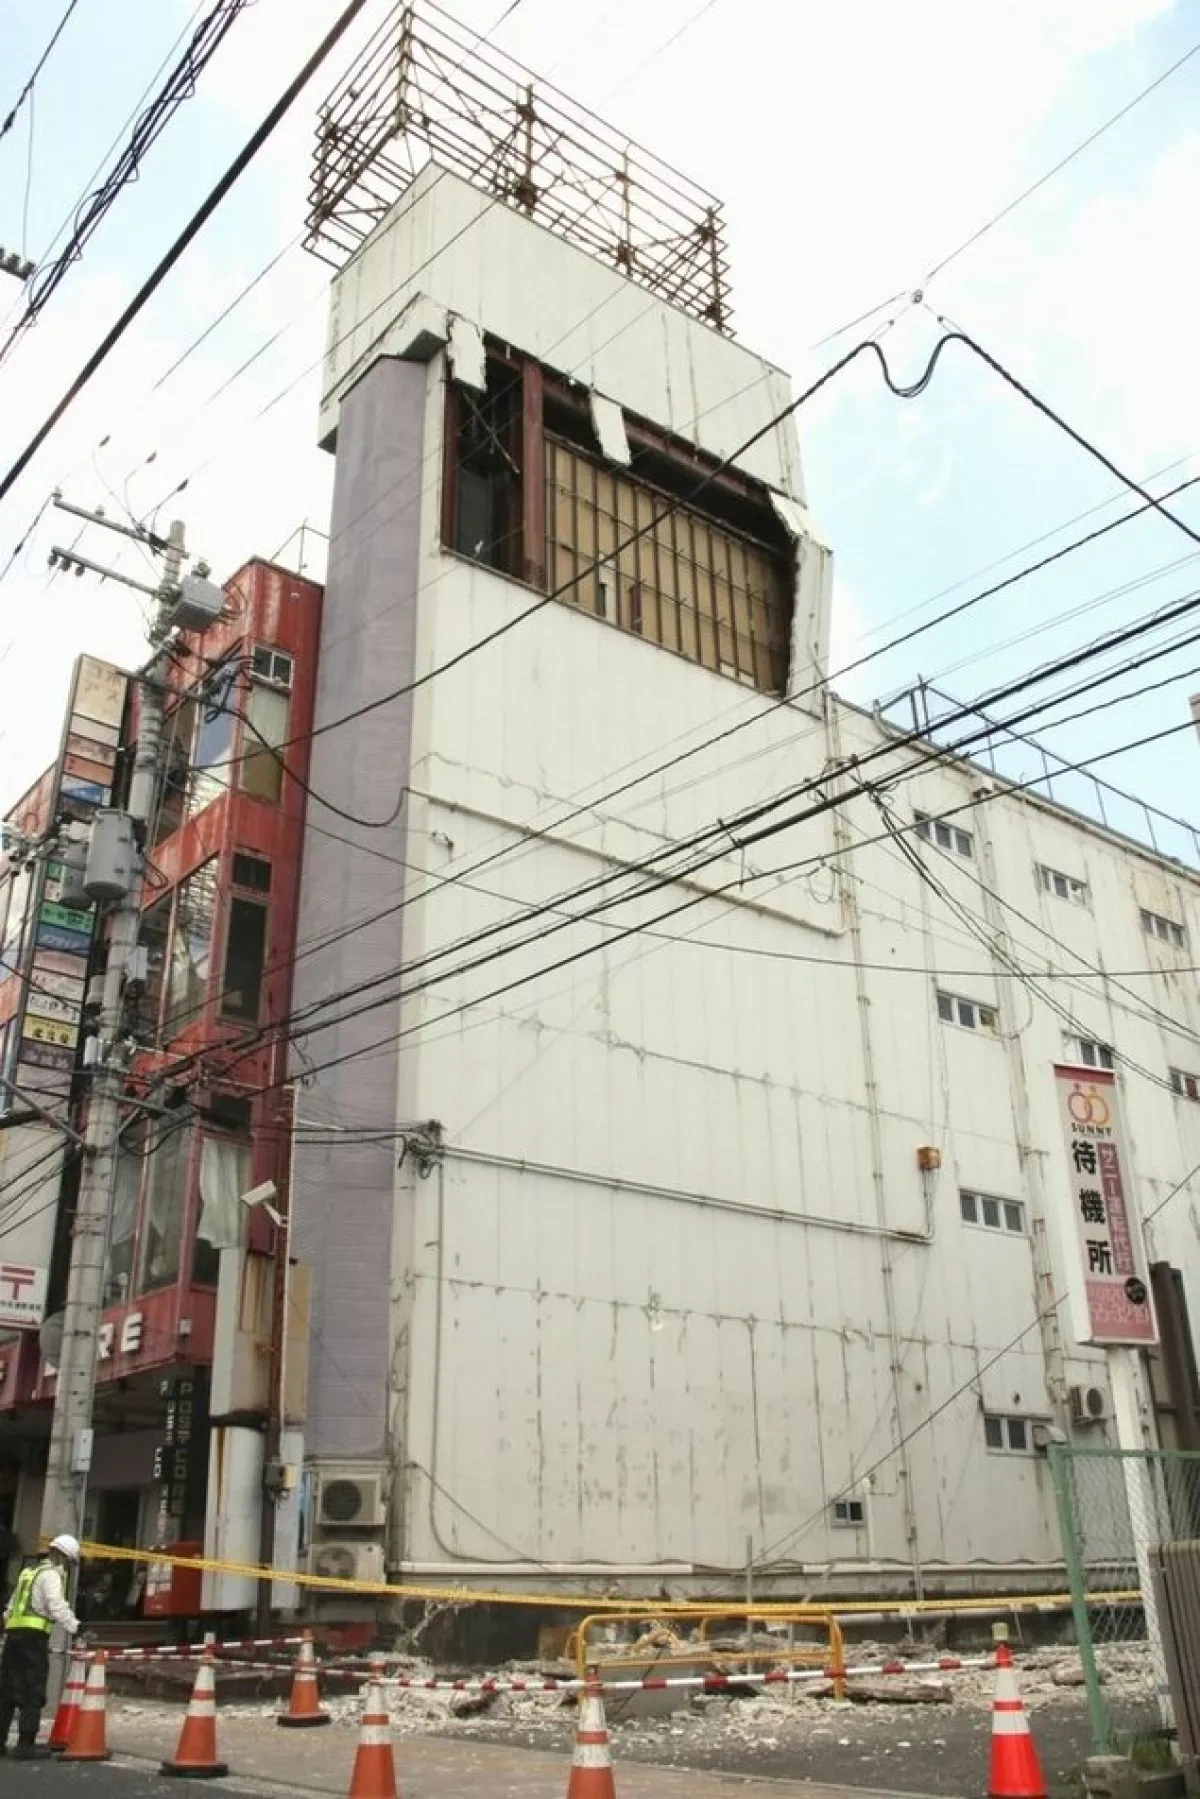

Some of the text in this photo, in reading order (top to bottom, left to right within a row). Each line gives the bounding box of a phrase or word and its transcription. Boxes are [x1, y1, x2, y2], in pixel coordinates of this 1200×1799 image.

[1071, 1122, 1112, 1136] SUNNY
[1071, 1140, 1112, 1275] 待機所
